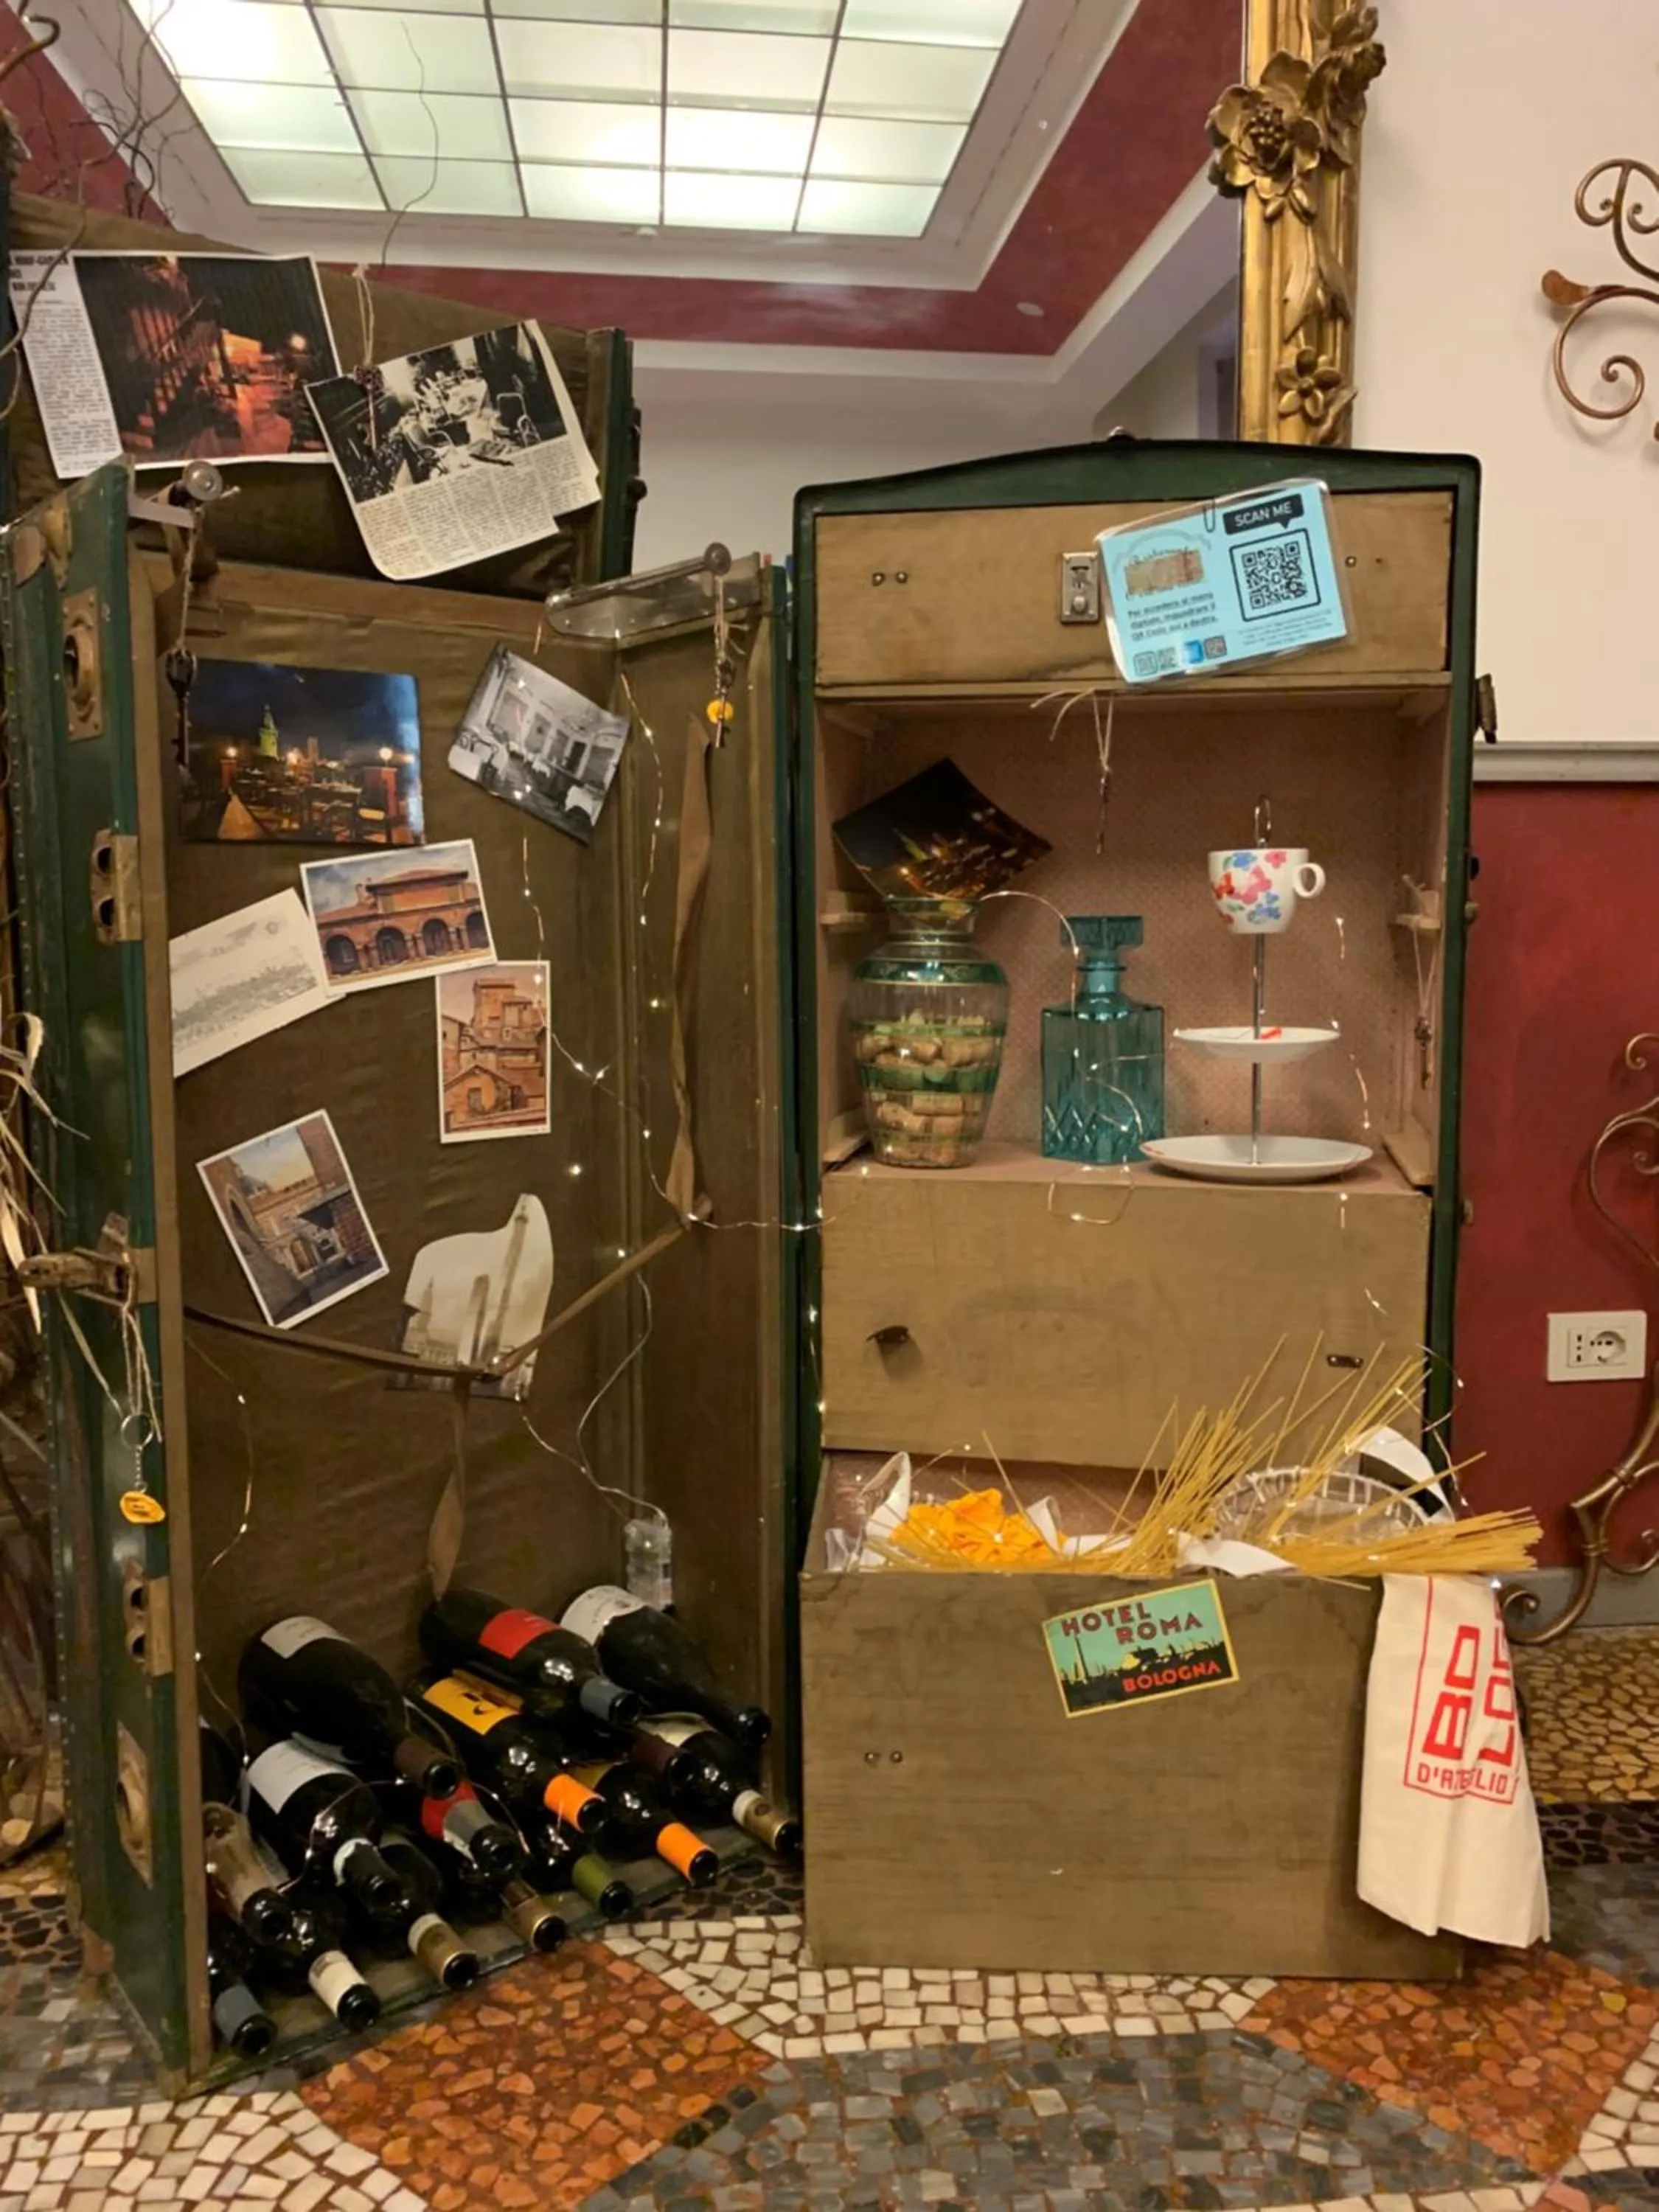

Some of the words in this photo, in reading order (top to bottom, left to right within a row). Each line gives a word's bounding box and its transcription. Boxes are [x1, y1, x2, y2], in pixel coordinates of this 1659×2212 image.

[1234, 507, 1270, 527] SCAN
[1273, 501, 1293, 517] ME
[1060, 1602, 1151, 1637] HOTEL
[1116, 1612, 1203, 1645] ROMA
[1122, 1660, 1221, 1693] BOLOGNA
